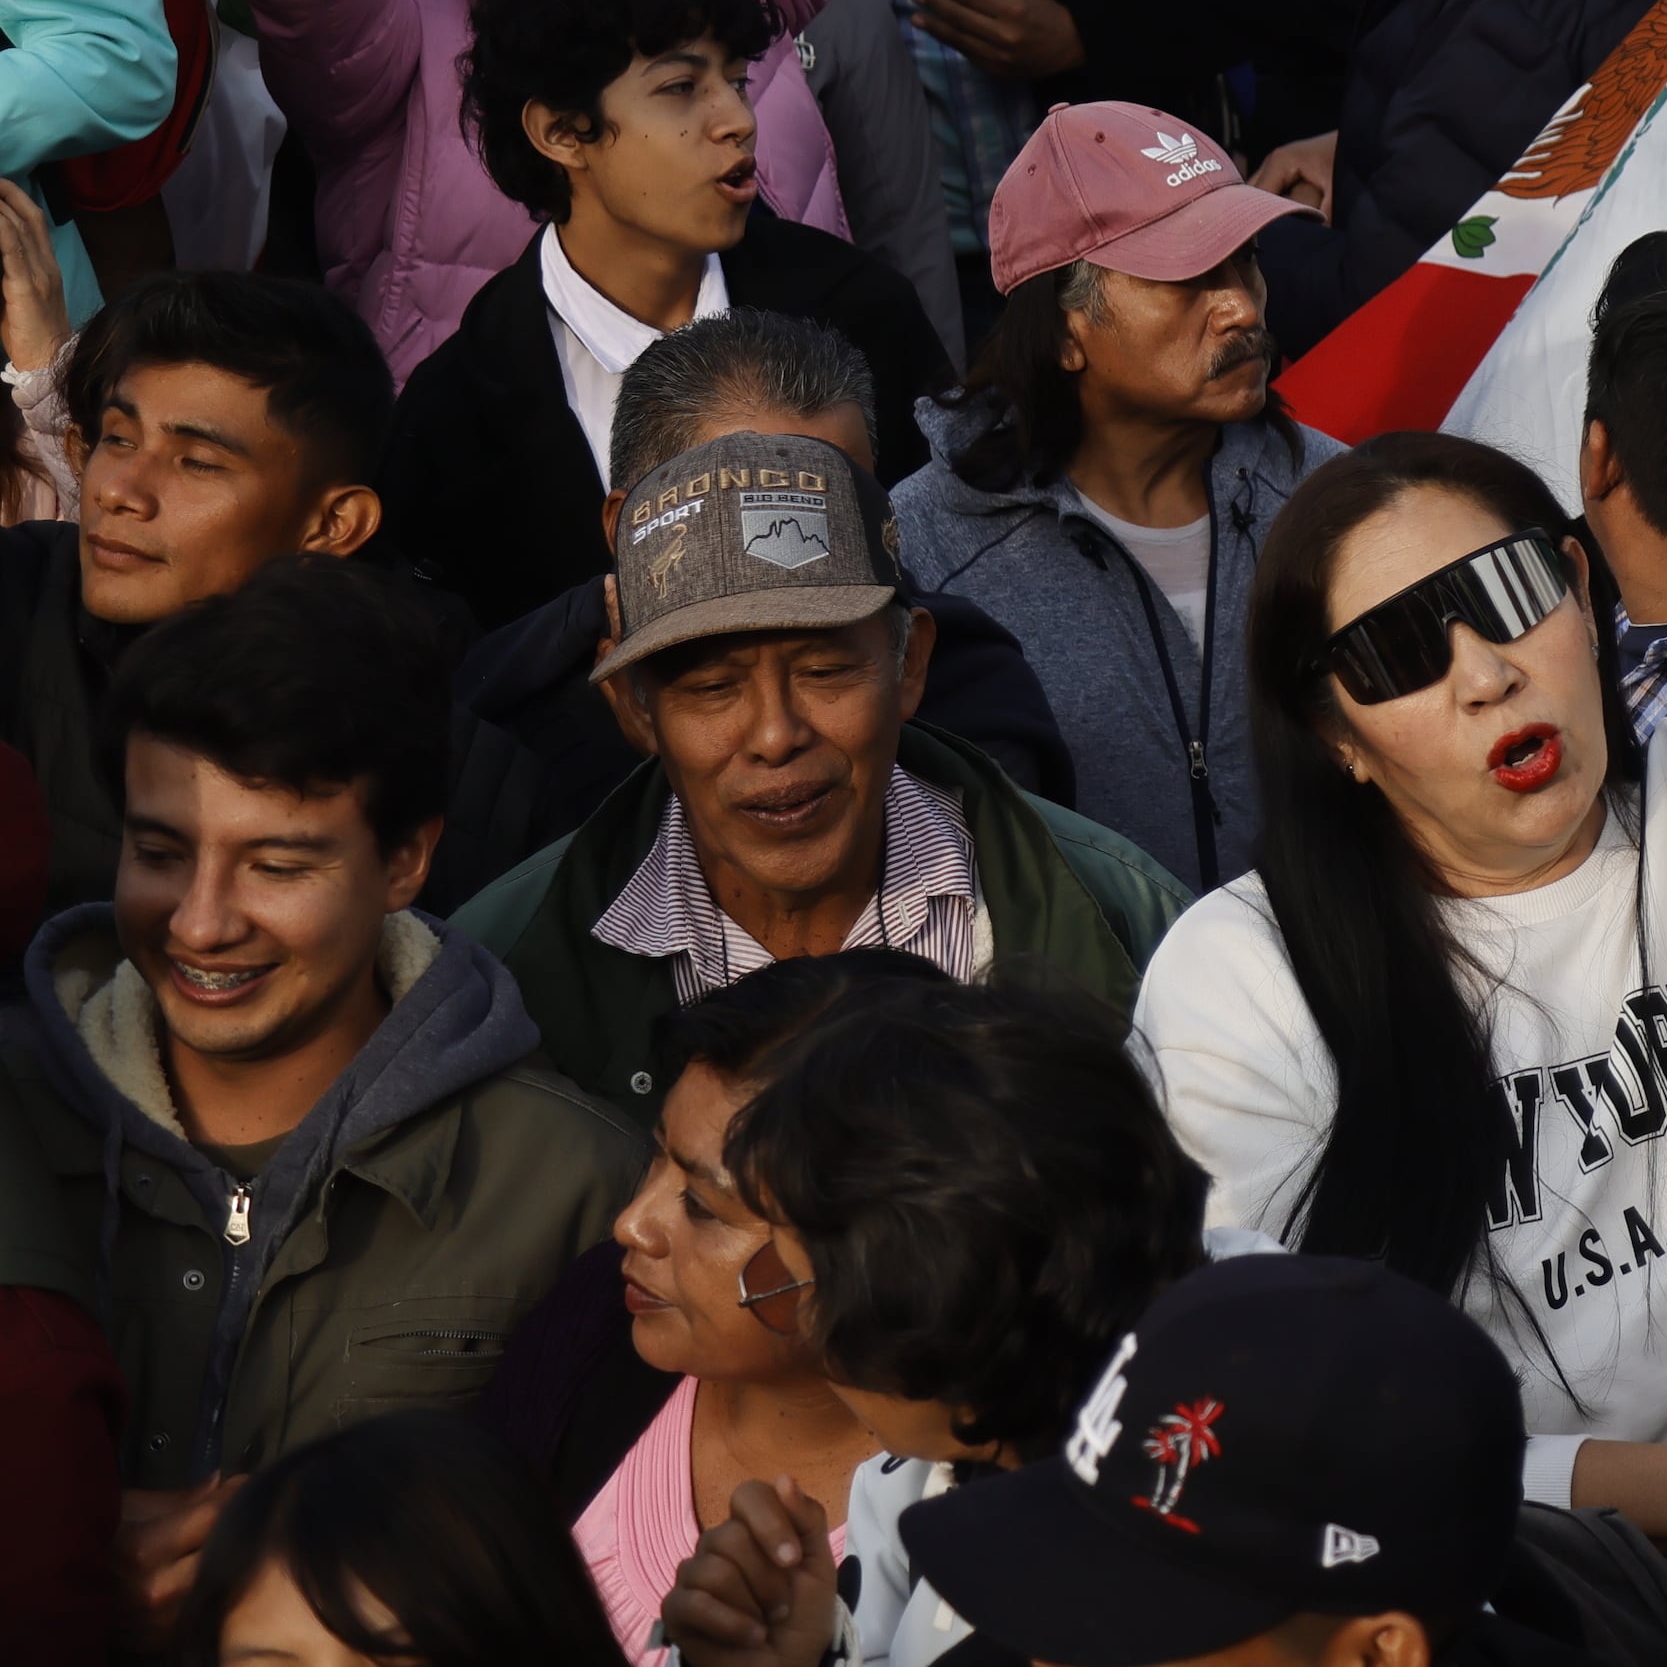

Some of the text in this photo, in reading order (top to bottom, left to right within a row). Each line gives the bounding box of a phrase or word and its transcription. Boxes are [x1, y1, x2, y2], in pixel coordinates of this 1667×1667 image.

[1166, 158, 1222, 187] adidas
[631, 467, 828, 526] BRONCO
[743, 493, 826, 507] BIG BEND
[632, 499, 705, 546] SPORT
